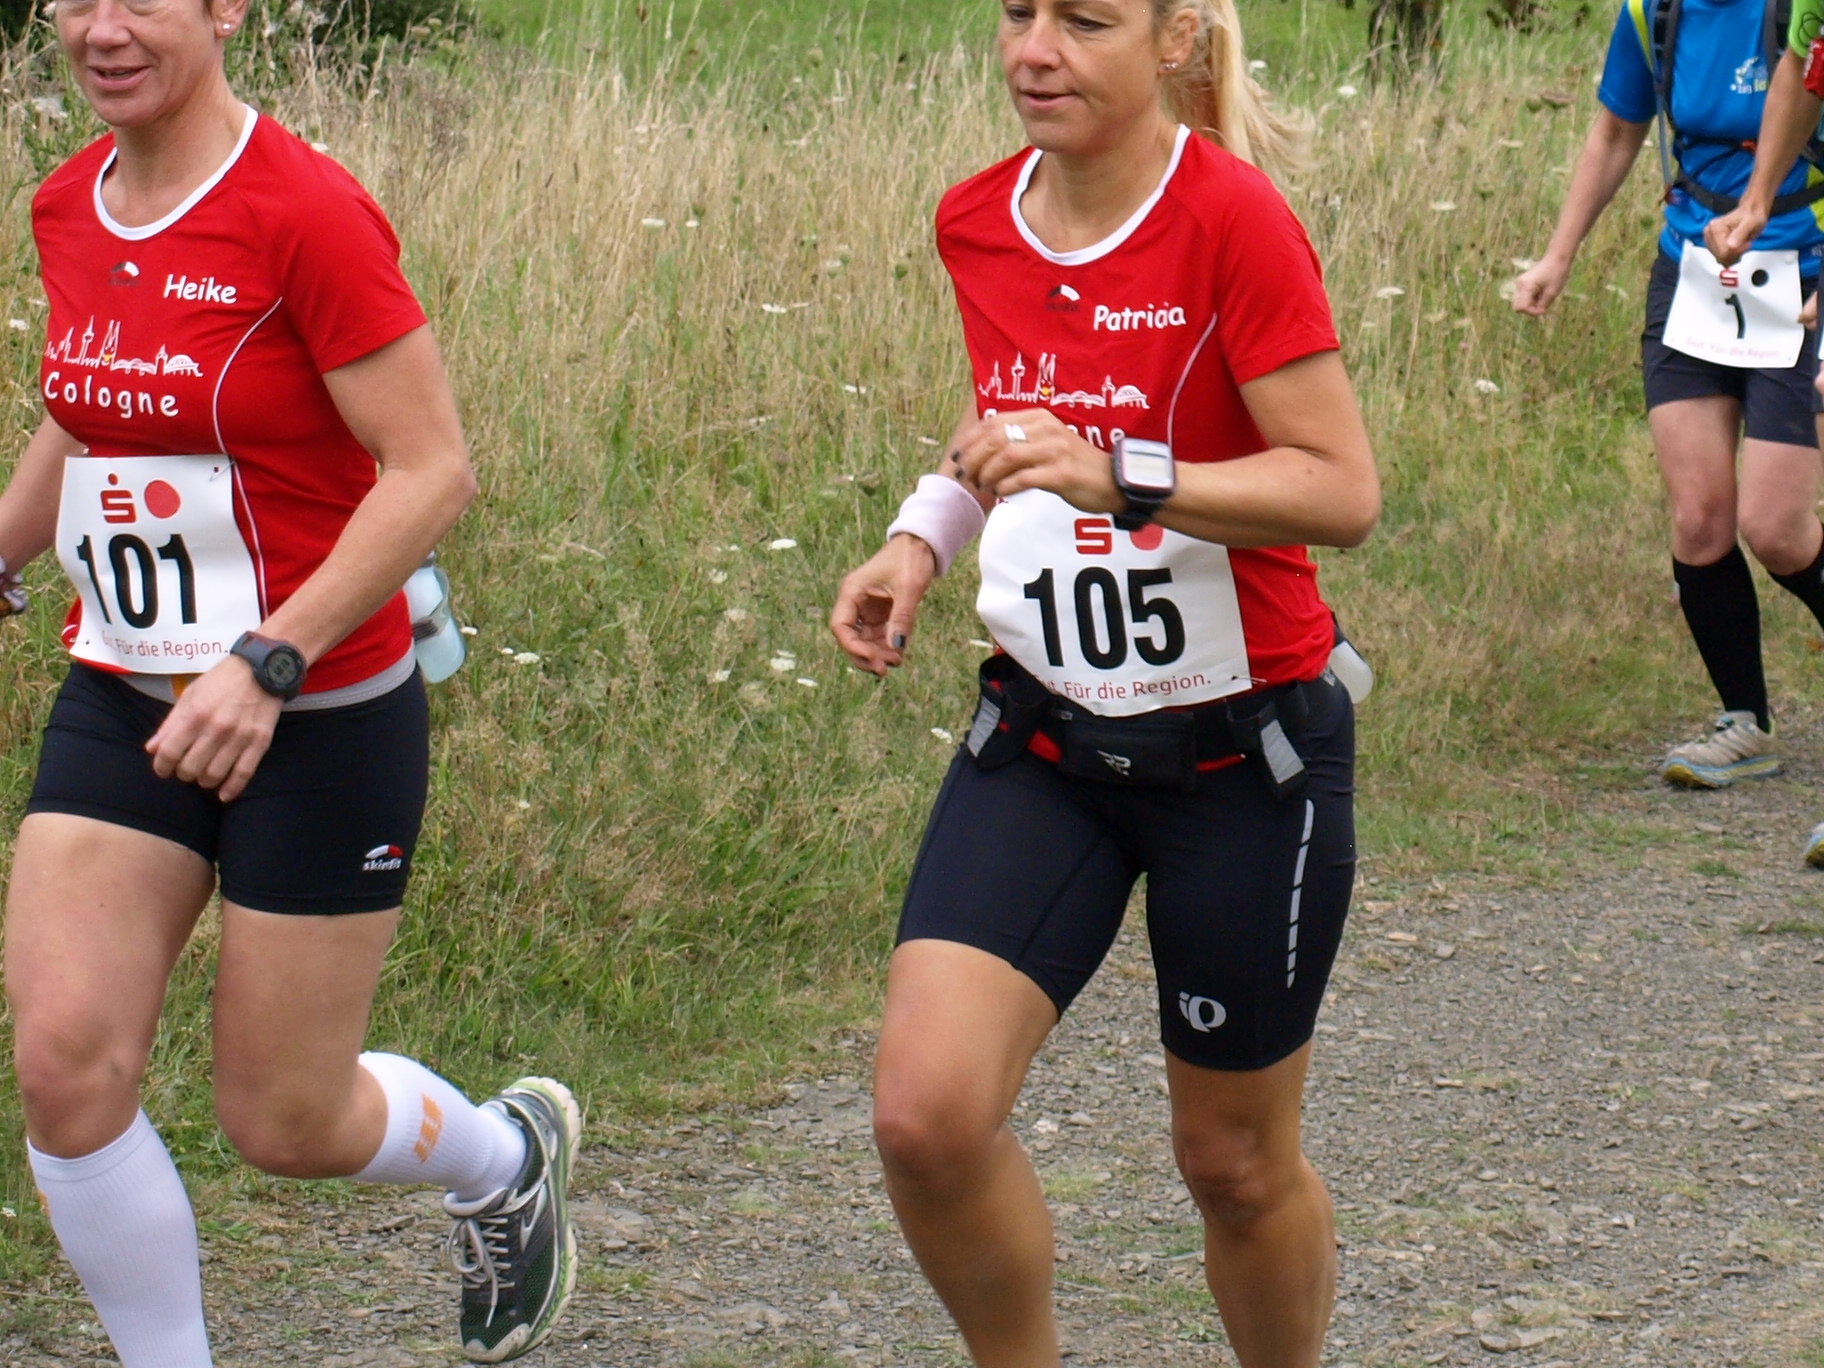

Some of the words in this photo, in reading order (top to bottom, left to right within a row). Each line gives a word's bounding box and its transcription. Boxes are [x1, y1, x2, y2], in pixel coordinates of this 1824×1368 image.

[164, 274, 236, 304] Heike
[1725, 293, 1745, 339] 1
[44, 371, 179, 419] Cologne
[76, 534, 198, 629] 101
[1023, 566, 1186, 670] 105
[137, 640, 160, 657] die
[163, 639, 230, 661] Region.
[1064, 680, 1092, 699] Für
[1097, 682, 1127, 700] die
[1132, 674, 1212, 697] Region.
